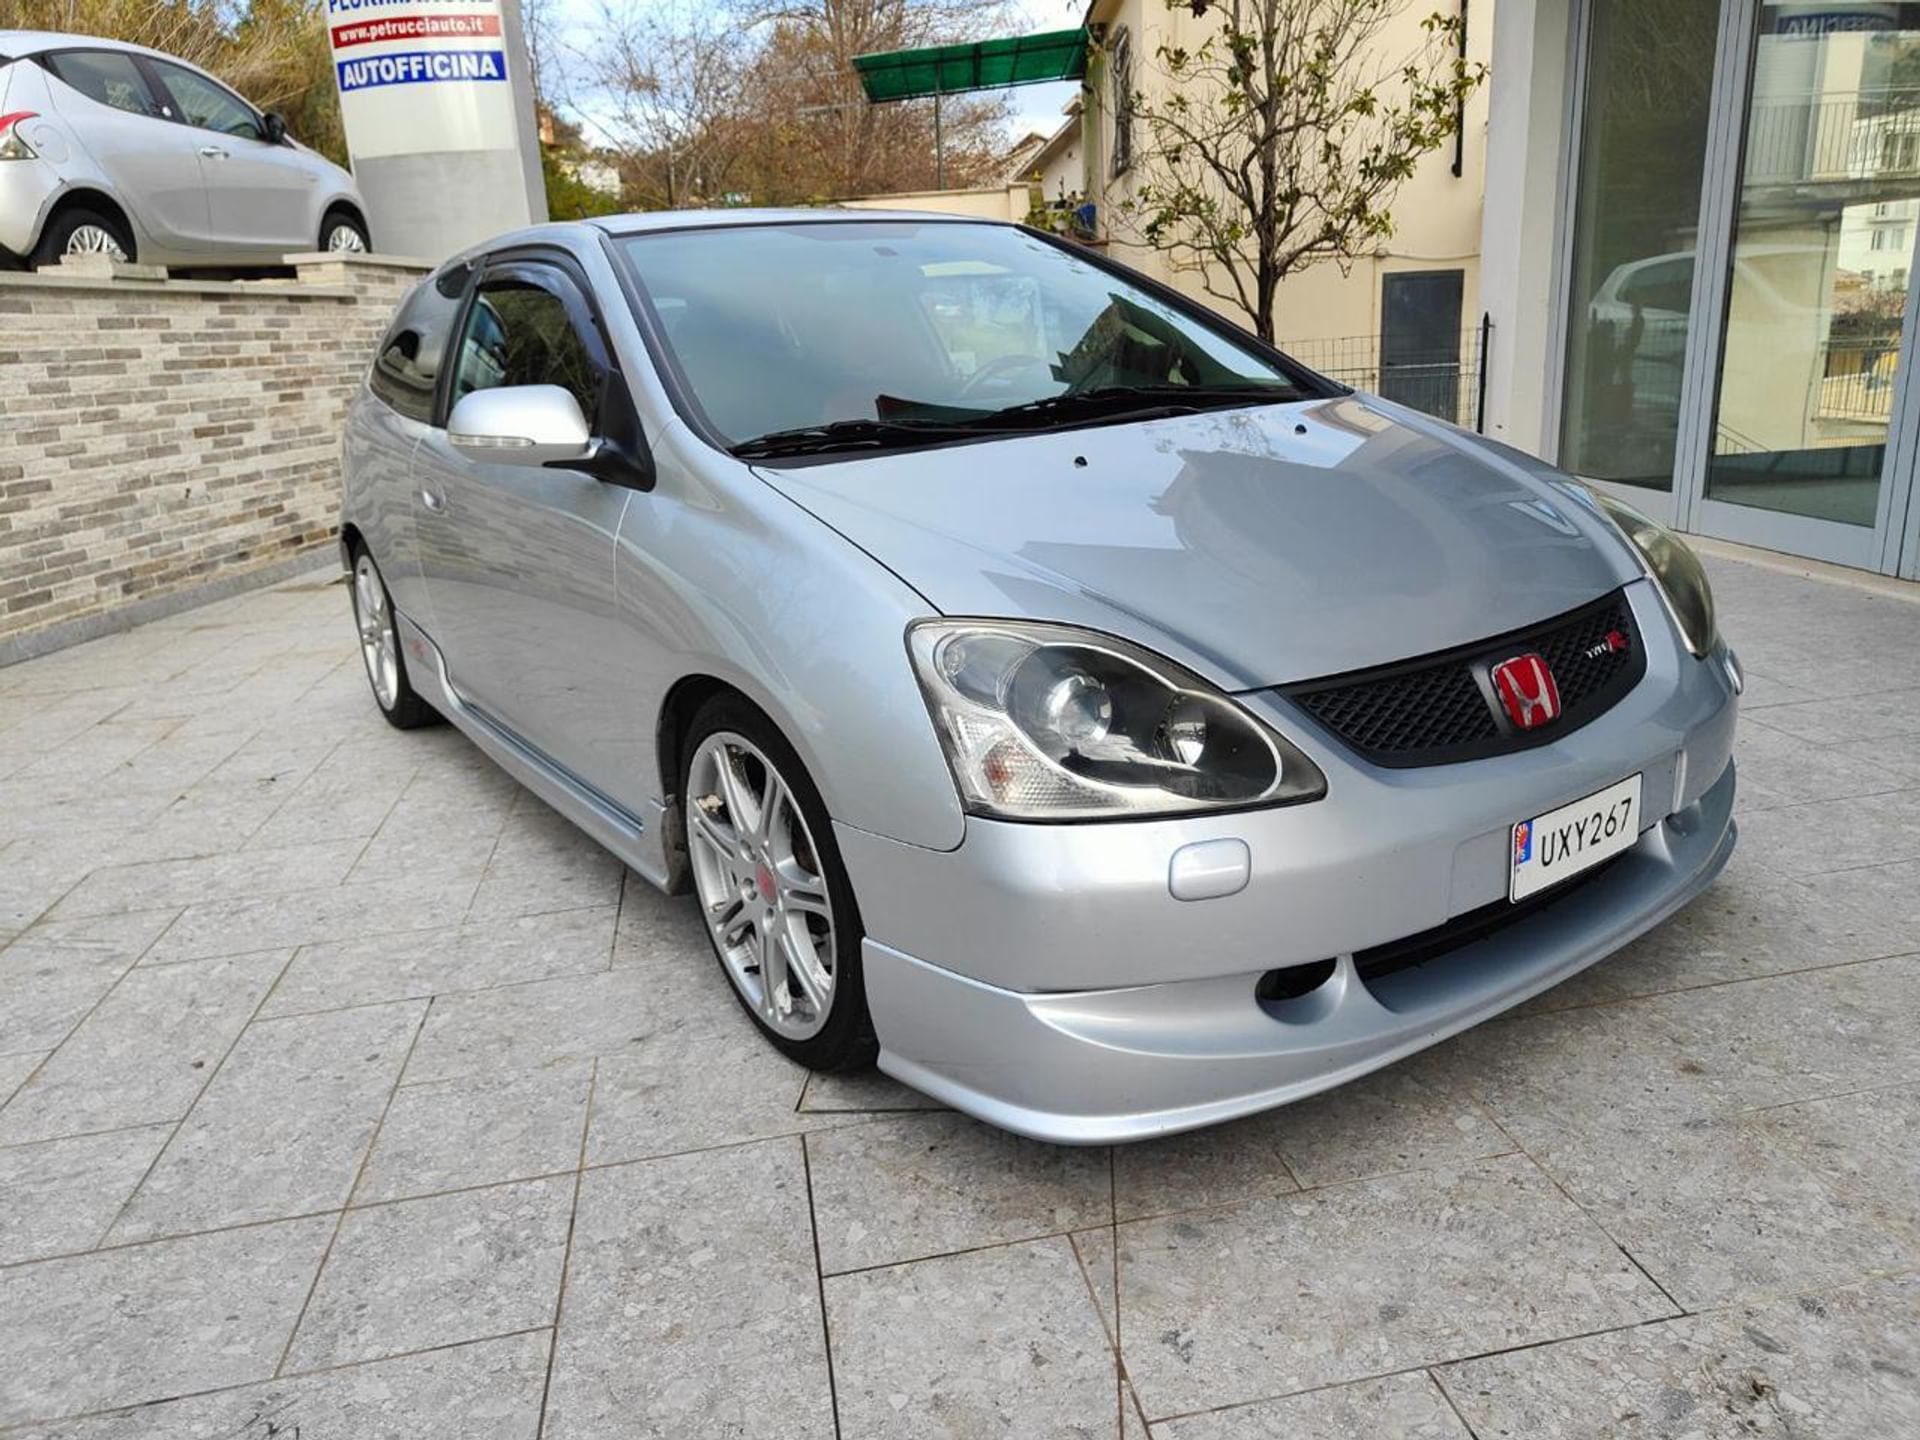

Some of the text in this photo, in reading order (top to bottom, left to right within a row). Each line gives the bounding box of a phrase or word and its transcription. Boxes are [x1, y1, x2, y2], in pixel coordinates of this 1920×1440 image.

[339, 17, 484, 42] www.petrucciauto.it
[344, 54, 498, 87] AUTOFFICINA
[1541, 797, 1632, 867] UXY267
